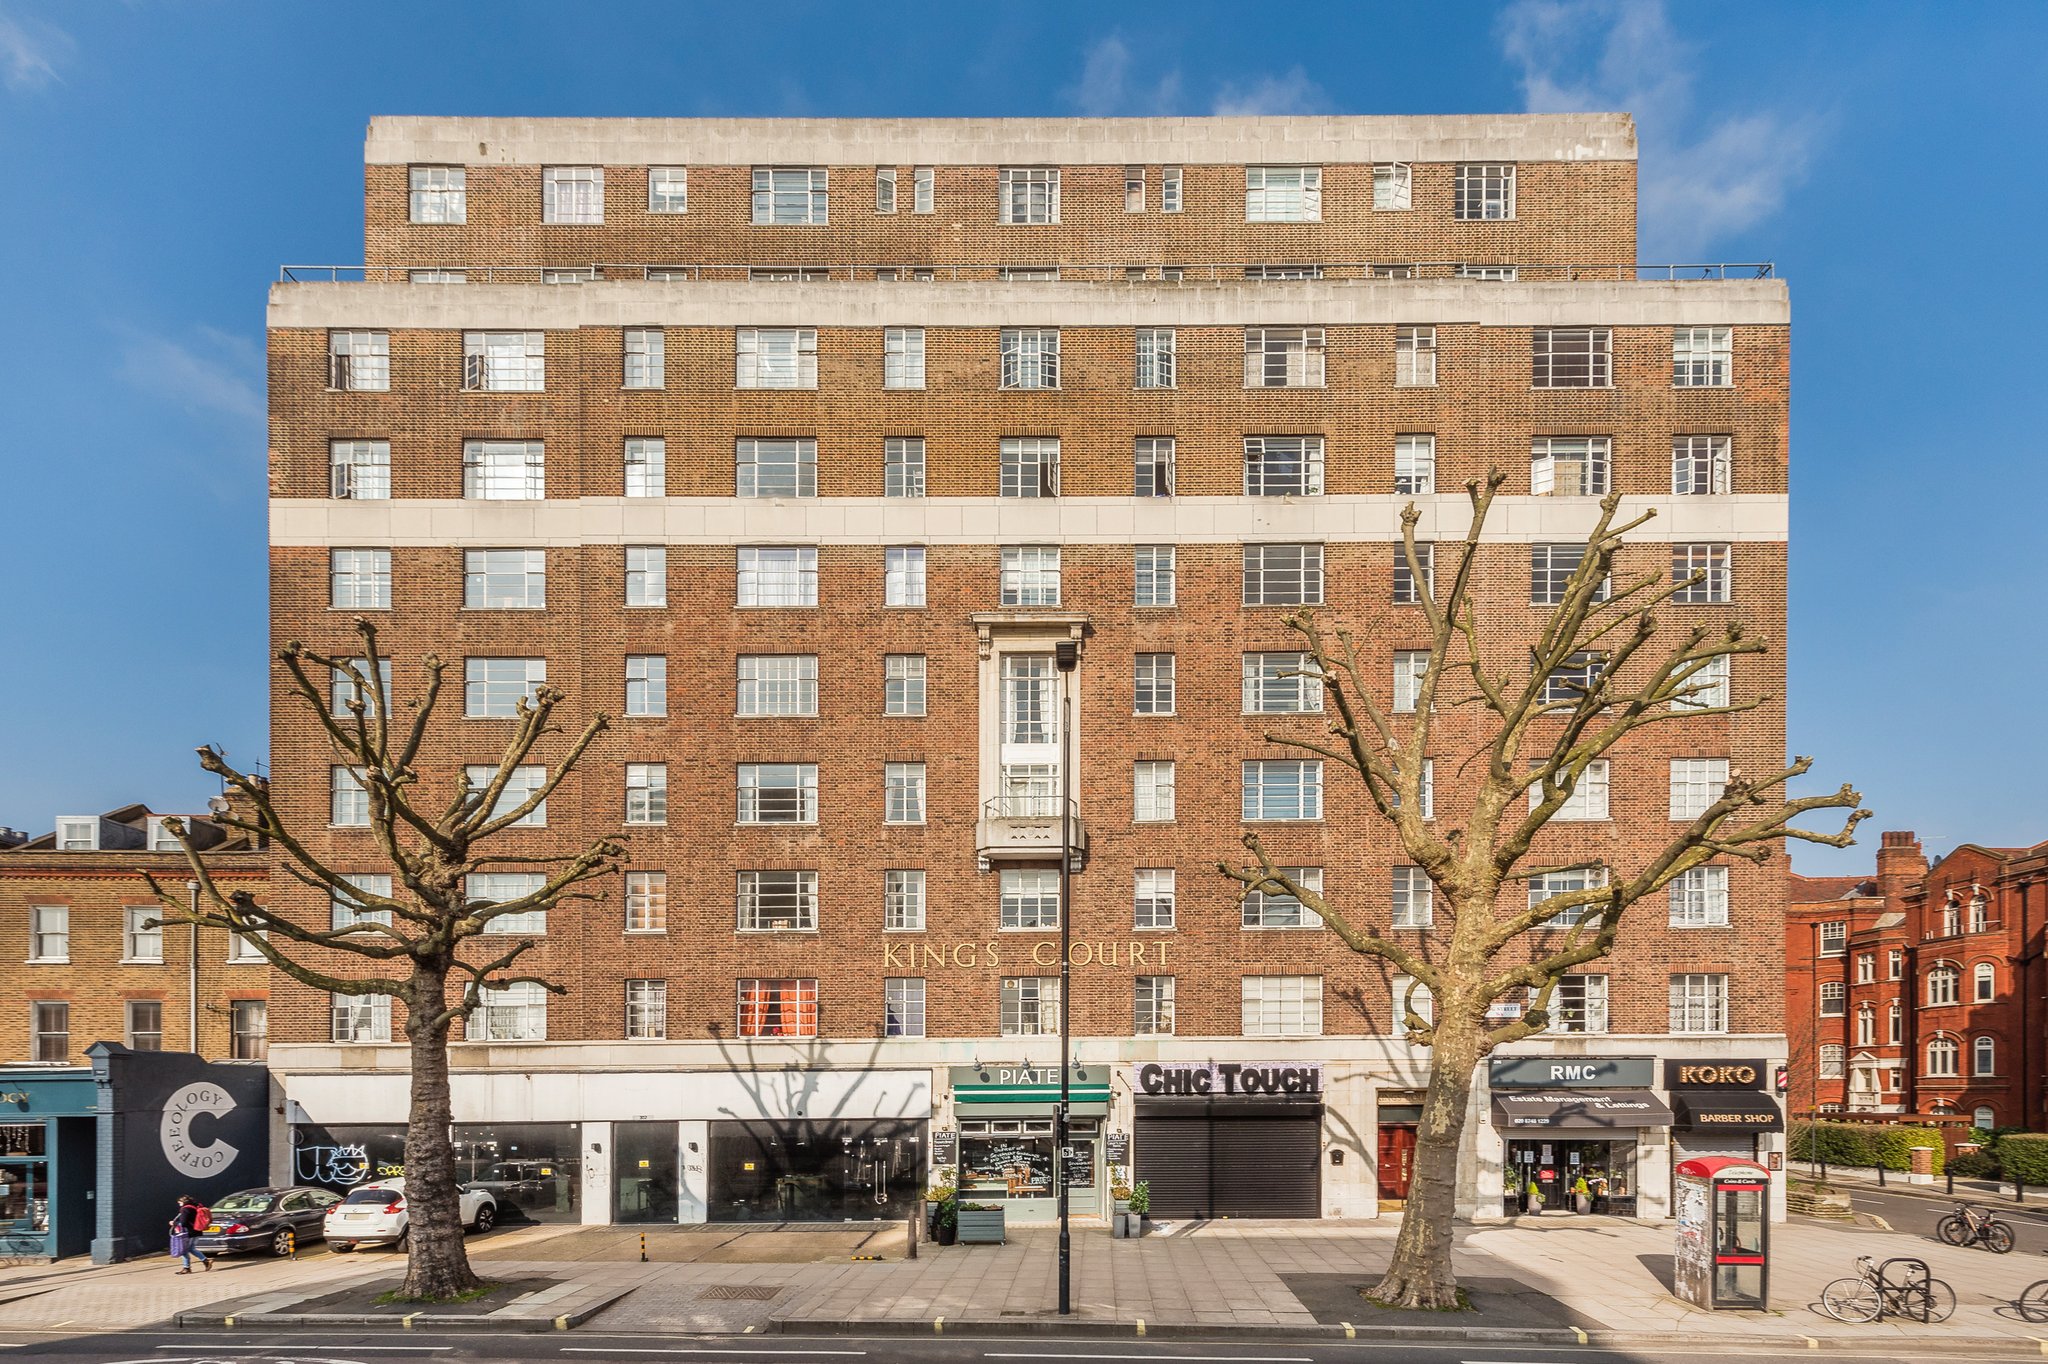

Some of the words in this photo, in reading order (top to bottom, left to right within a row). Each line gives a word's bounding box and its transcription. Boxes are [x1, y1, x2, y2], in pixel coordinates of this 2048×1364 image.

[884, 942, 1000, 968] KINGS
[1032, 941, 1174, 967] COURT
[1000, 1069, 1059, 1085] PIATE
[1140, 1063, 1212, 1096] CHIC
[1218, 1064, 1319, 1096] TOUCH
[1550, 1065, 1596, 1080] RMC
[1680, 1065, 1756, 1084] KOKO
[1508, 1095, 1543, 1103] Estate
[1543, 1096, 1613, 1104] Management
[1605, 1102, 1650, 1110] Lettings
[1700, 1114, 1742, 1123] BARBER
[1744, 1114, 1774, 1123] SHOP
[169, 1090, 224, 1168] COFFEEOLOGY
